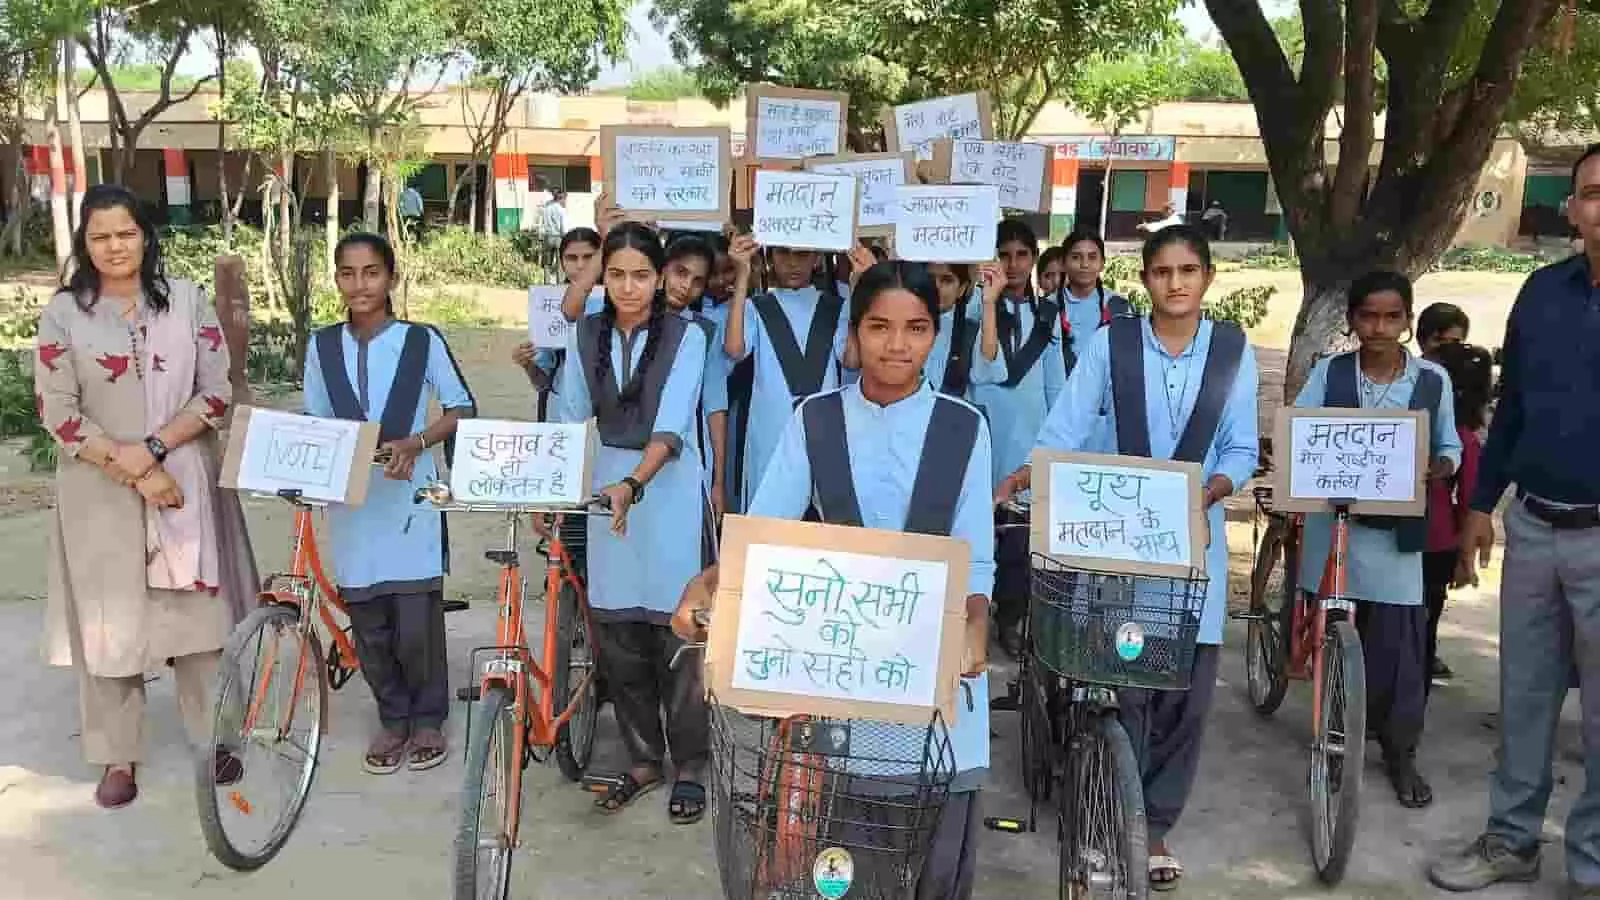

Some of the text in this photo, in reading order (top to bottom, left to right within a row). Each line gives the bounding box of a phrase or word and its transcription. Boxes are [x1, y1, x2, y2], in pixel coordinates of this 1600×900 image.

[766, 180, 840, 209] मतदान
[911, 223, 985, 247] मतदाता
[463, 430, 569, 462] चुनाव है
[1306, 423, 1401, 450] मतदान
[549, 471, 568, 497] है
[1077, 470, 1151, 517] यूथ
[1374, 467, 1392, 496] है
[1056, 505, 1162, 548] मतदान के
[1128, 530, 1181, 559] साथ
[761, 557, 926, 629] सुनो सभी
[818, 608, 863, 648] को
[742, 633, 797, 681] चुनो
[874, 652, 918, 693] को
